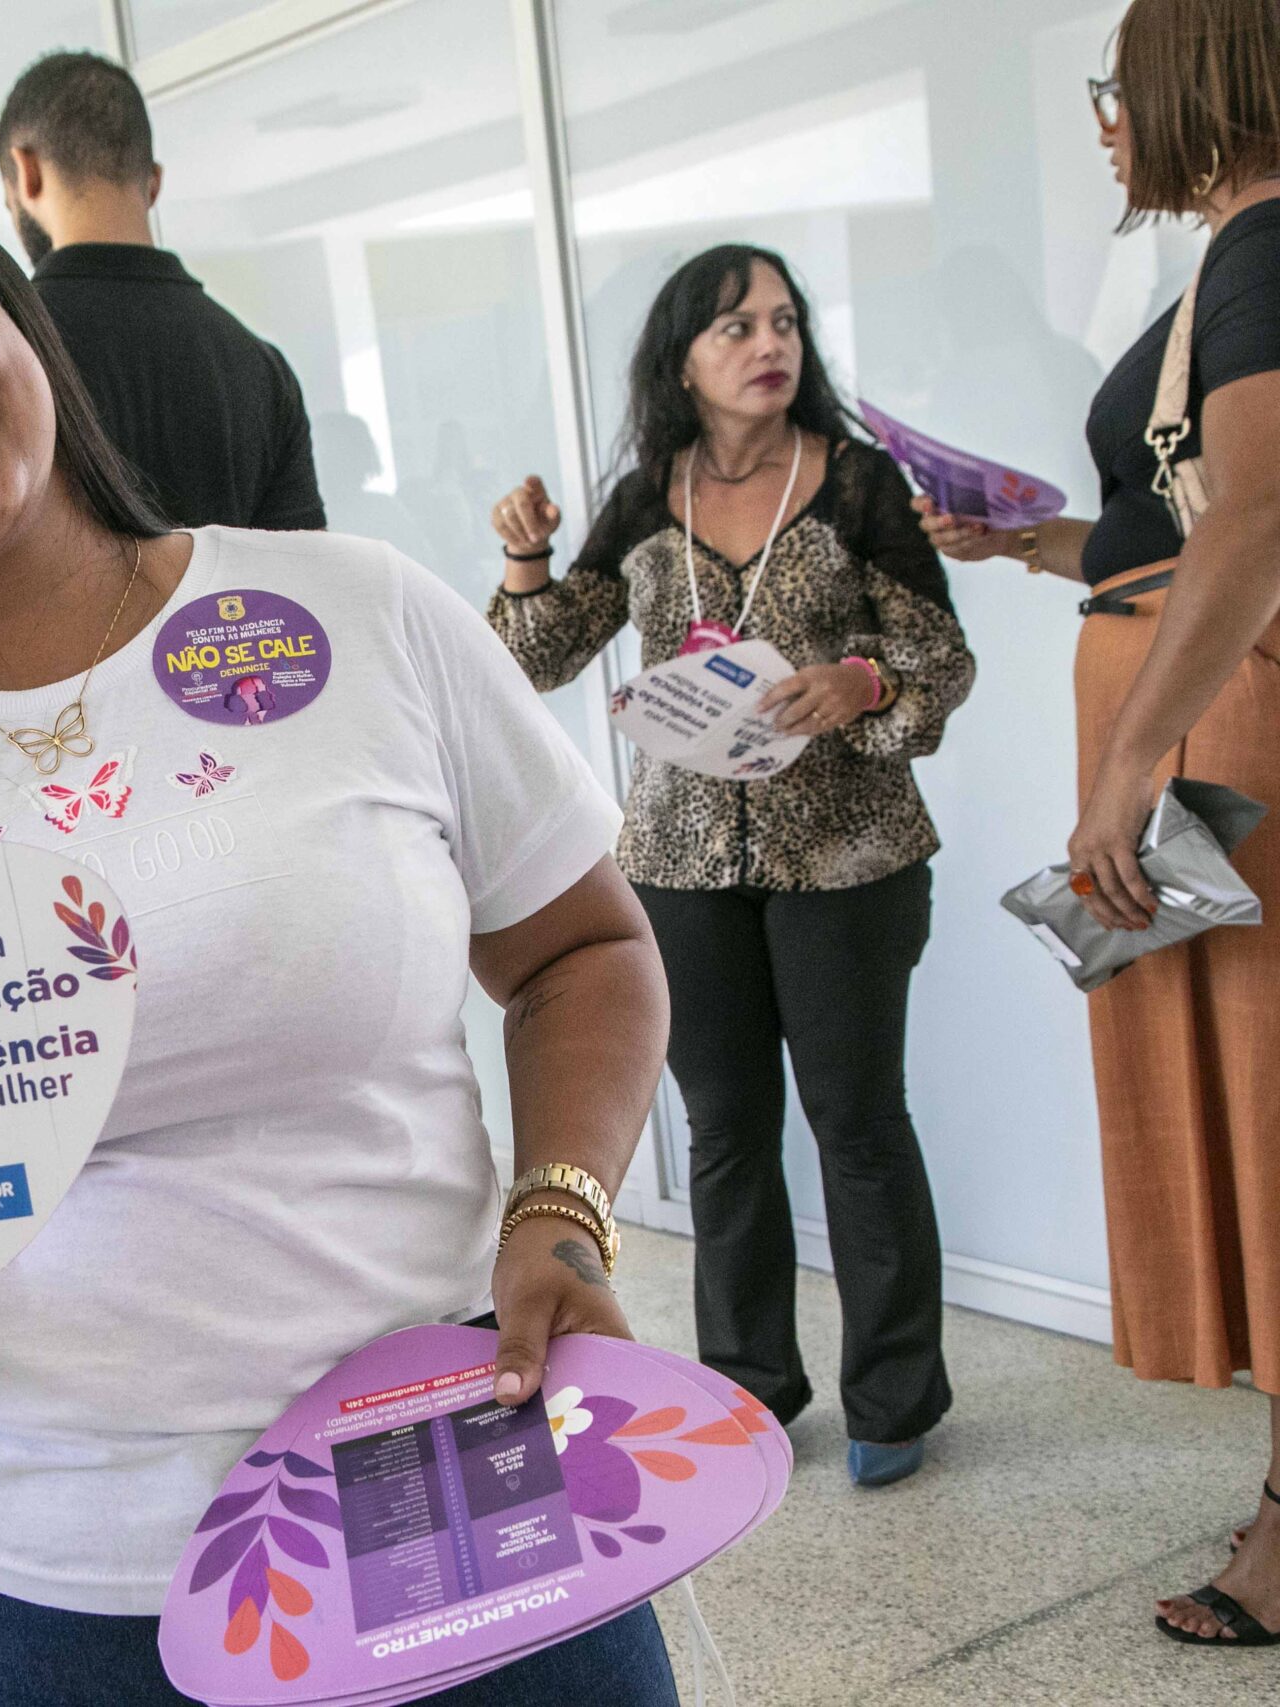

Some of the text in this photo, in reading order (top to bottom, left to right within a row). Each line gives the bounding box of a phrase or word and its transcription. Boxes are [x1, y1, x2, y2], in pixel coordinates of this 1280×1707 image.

[185, 618, 285, 638] PELO FIM DA VIOLÊNCIA
[192, 626, 282, 645] CONTRA AS MULHERES
[166, 634, 316, 674] NÃO SE CALE
[219, 662, 271, 678] DENUNCIE
[433, 1367, 486, 1388] 98507-5609
[365, 1383, 425, 1404] Atendimento
[434, 1393, 466, 1409] ajuda:
[326, 1376, 494, 1428] oteropolitana Irmã Dulce (CAMSID)
[345, 1398, 364, 1409] 24h
[384, 1413, 398, 1422] de
[399, 1403, 432, 1418] Centro
[322, 1416, 383, 1438] Atendimento
[391, 1425, 414, 1436] MATAR
[314, 1432, 321, 1441] à
[493, 1459, 505, 1468] SE
[500, 1531, 541, 1549] VIOLÊNCIA
[509, 1525, 535, 1539] TENDE
[496, 1533, 557, 1558] TOME CUIDADO!
[557, 1568, 586, 1583] Tome
[532, 1578, 556, 1591] uma
[496, 1586, 531, 1603] atitude
[466, 1597, 495, 1612] antes
[421, 1614, 443, 1626] seja
[444, 1607, 464, 1619] que
[372, 1586, 569, 1658] VIOLENTÔMETRO
[393, 1621, 421, 1635] tarde
[355, 1630, 392, 1647] demais
